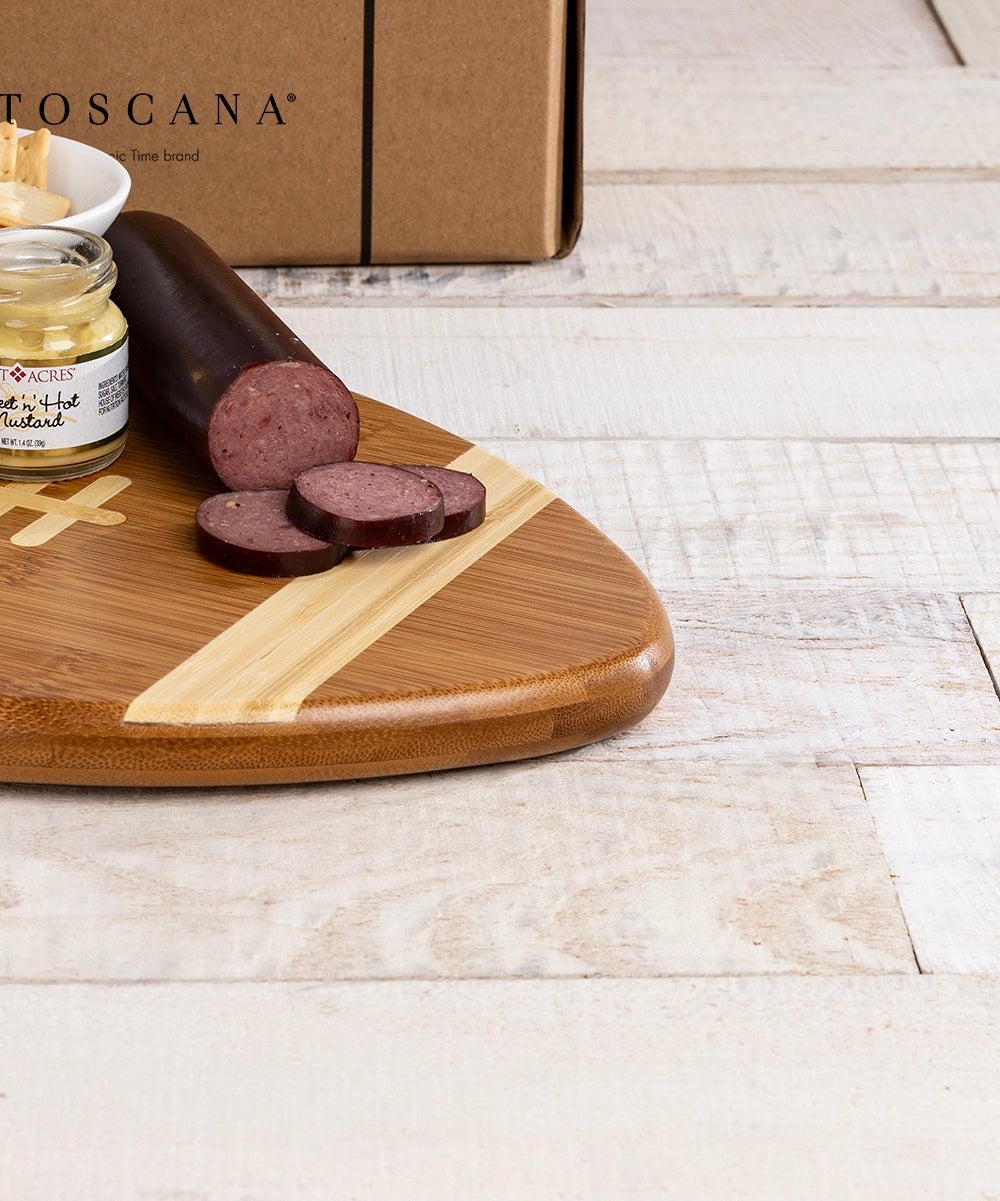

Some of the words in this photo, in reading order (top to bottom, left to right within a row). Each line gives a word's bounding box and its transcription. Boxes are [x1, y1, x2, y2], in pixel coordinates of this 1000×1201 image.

[131, 149, 159, 162] Time
[163, 148, 200, 162] brand
[27, 367, 76, 383] ACRES
[39, 391, 80, 413] Hot
